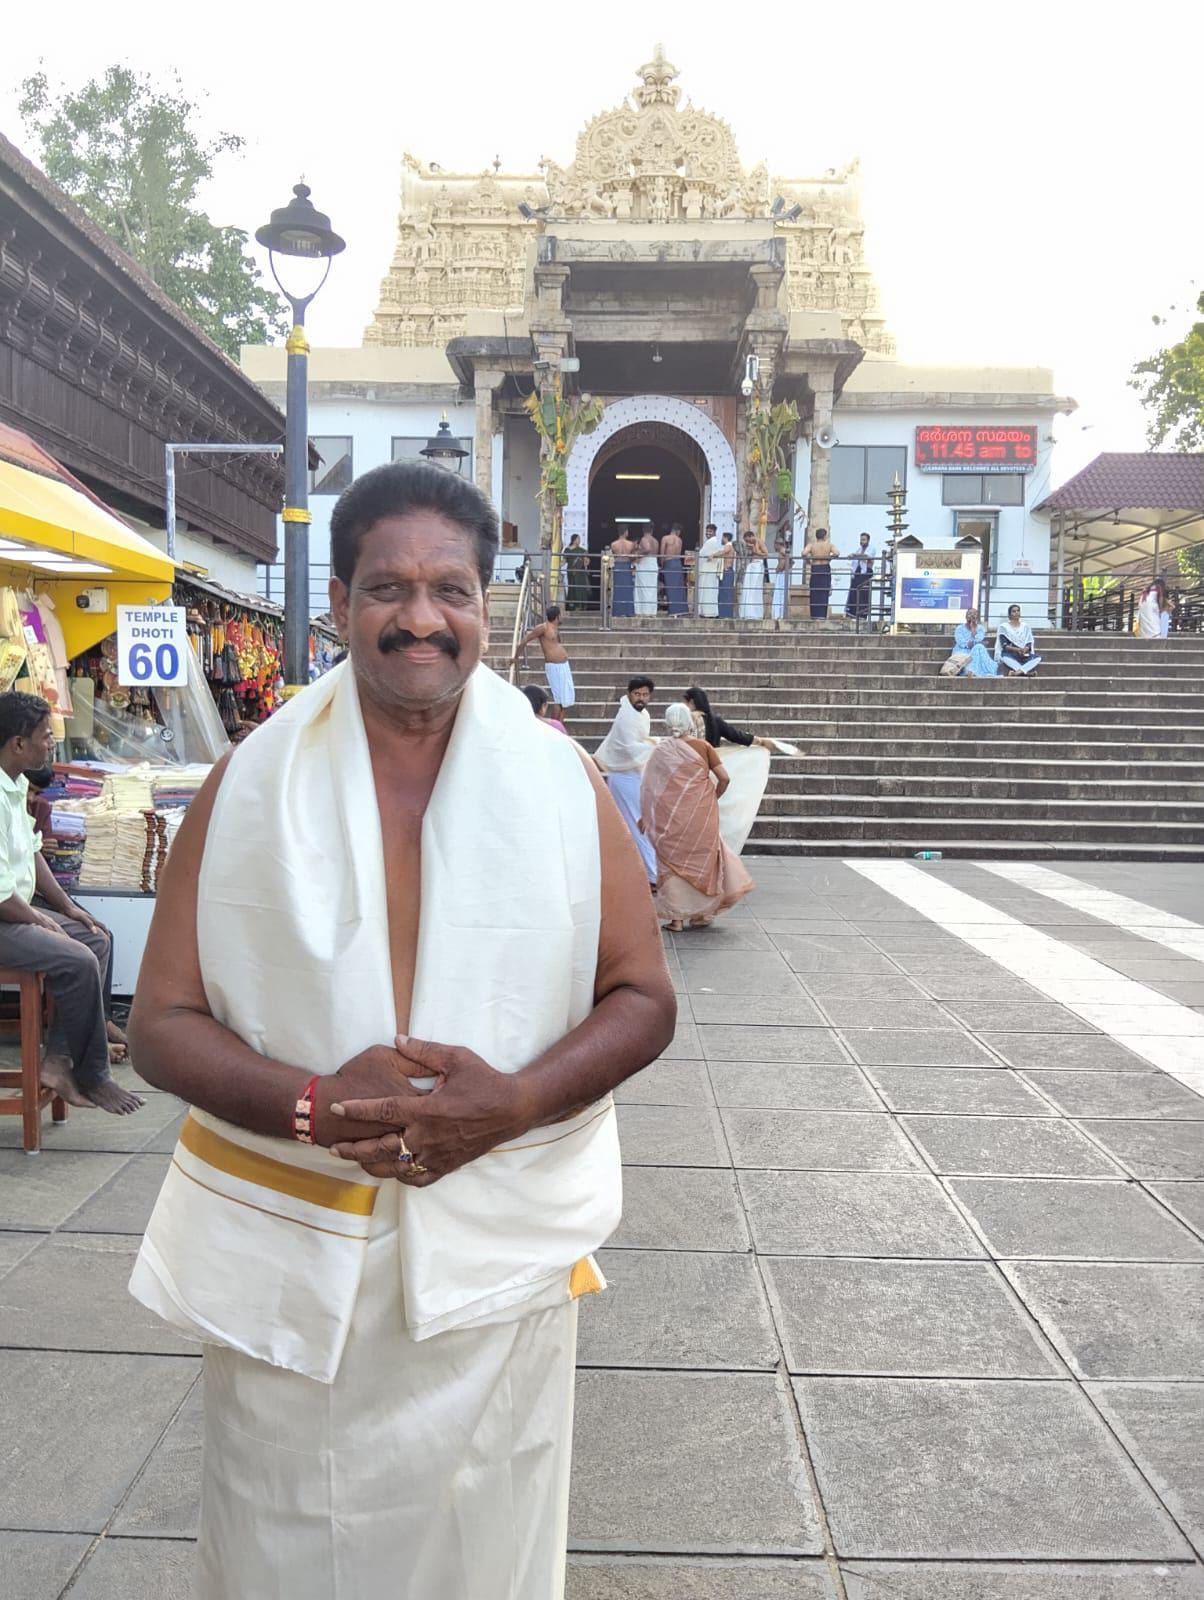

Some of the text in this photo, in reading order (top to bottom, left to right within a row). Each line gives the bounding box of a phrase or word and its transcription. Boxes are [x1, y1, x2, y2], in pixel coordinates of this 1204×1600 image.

[919, 426, 1031, 442] ദർശന സമയം
[931, 443, 975, 458] 11.45
[125, 611, 178, 622] TEMPLE
[131, 627, 173, 639] DHOTI
[128, 643, 179, 680] 60
